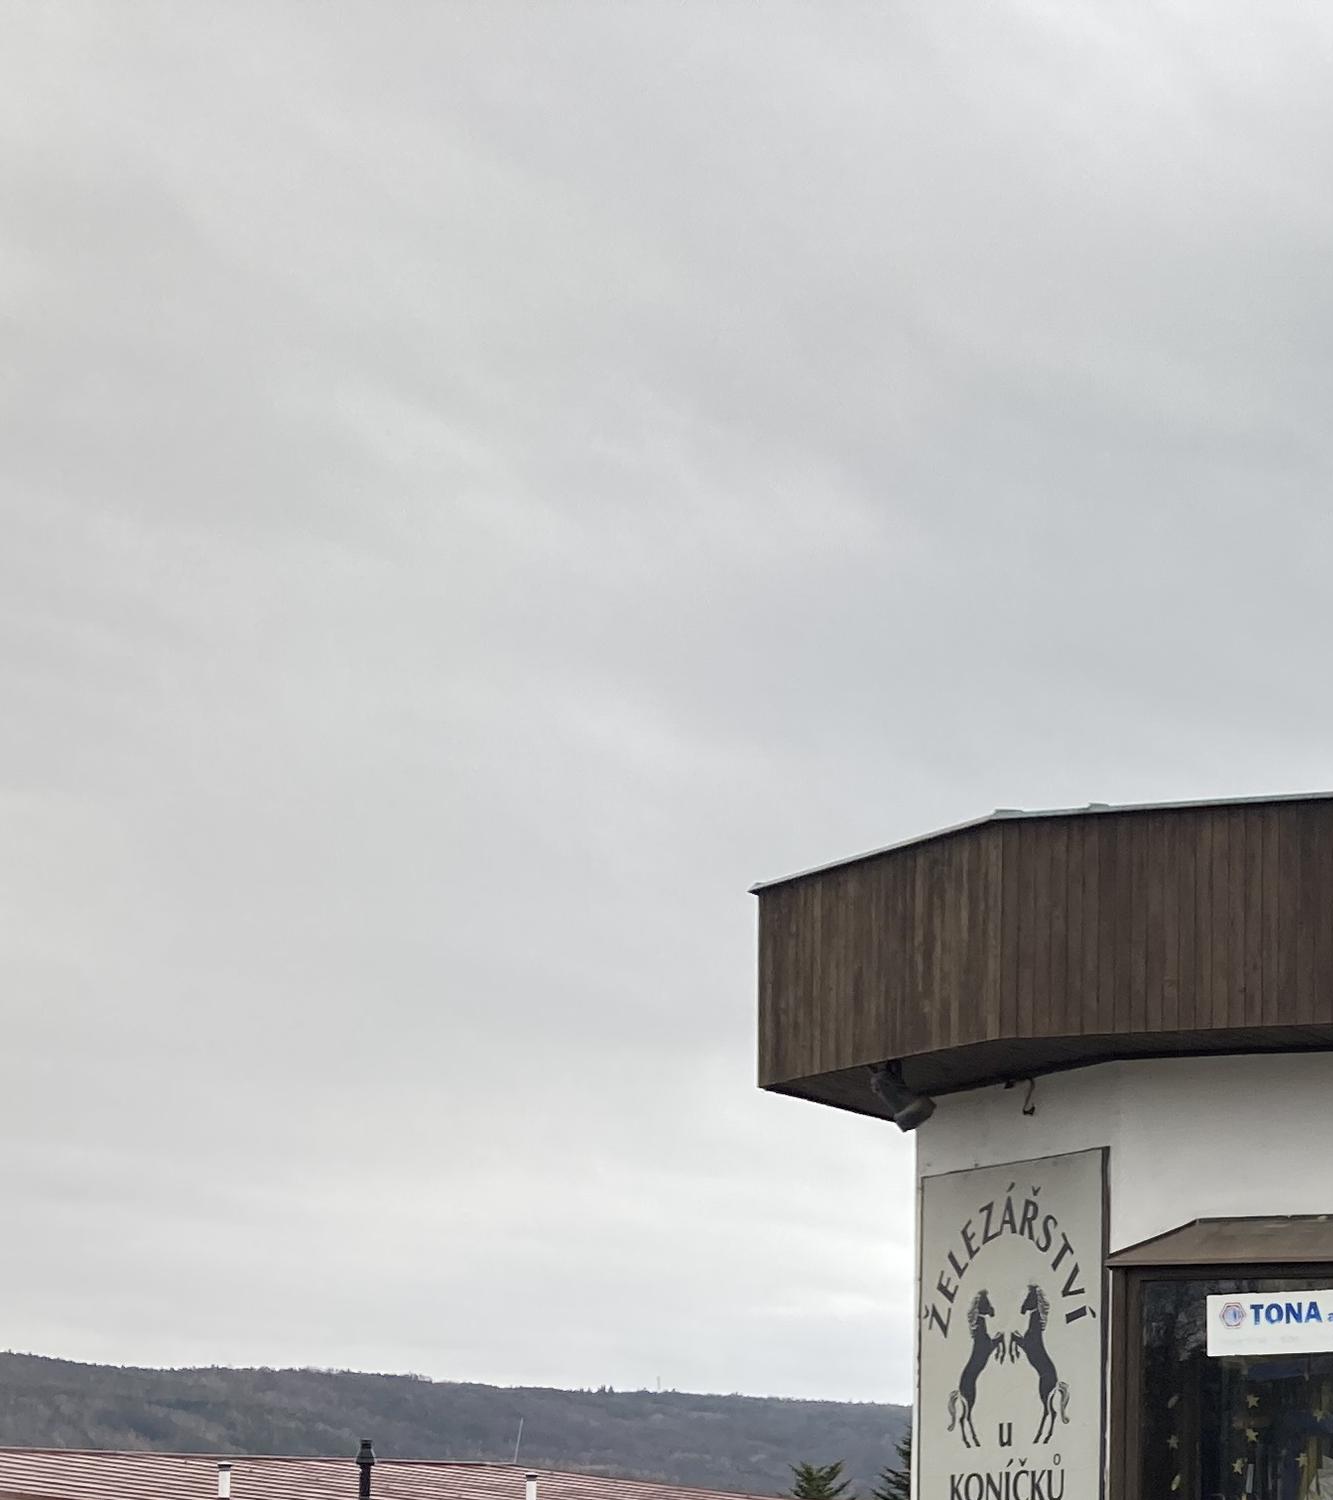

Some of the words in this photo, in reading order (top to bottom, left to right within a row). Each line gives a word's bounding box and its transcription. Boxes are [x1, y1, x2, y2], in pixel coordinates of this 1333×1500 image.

[923, 1182, 1097, 1339] ŽELEZÁŘSTVÍ
[1250, 1301, 1323, 1326] TONA
[998, 1422, 1013, 1448] u
